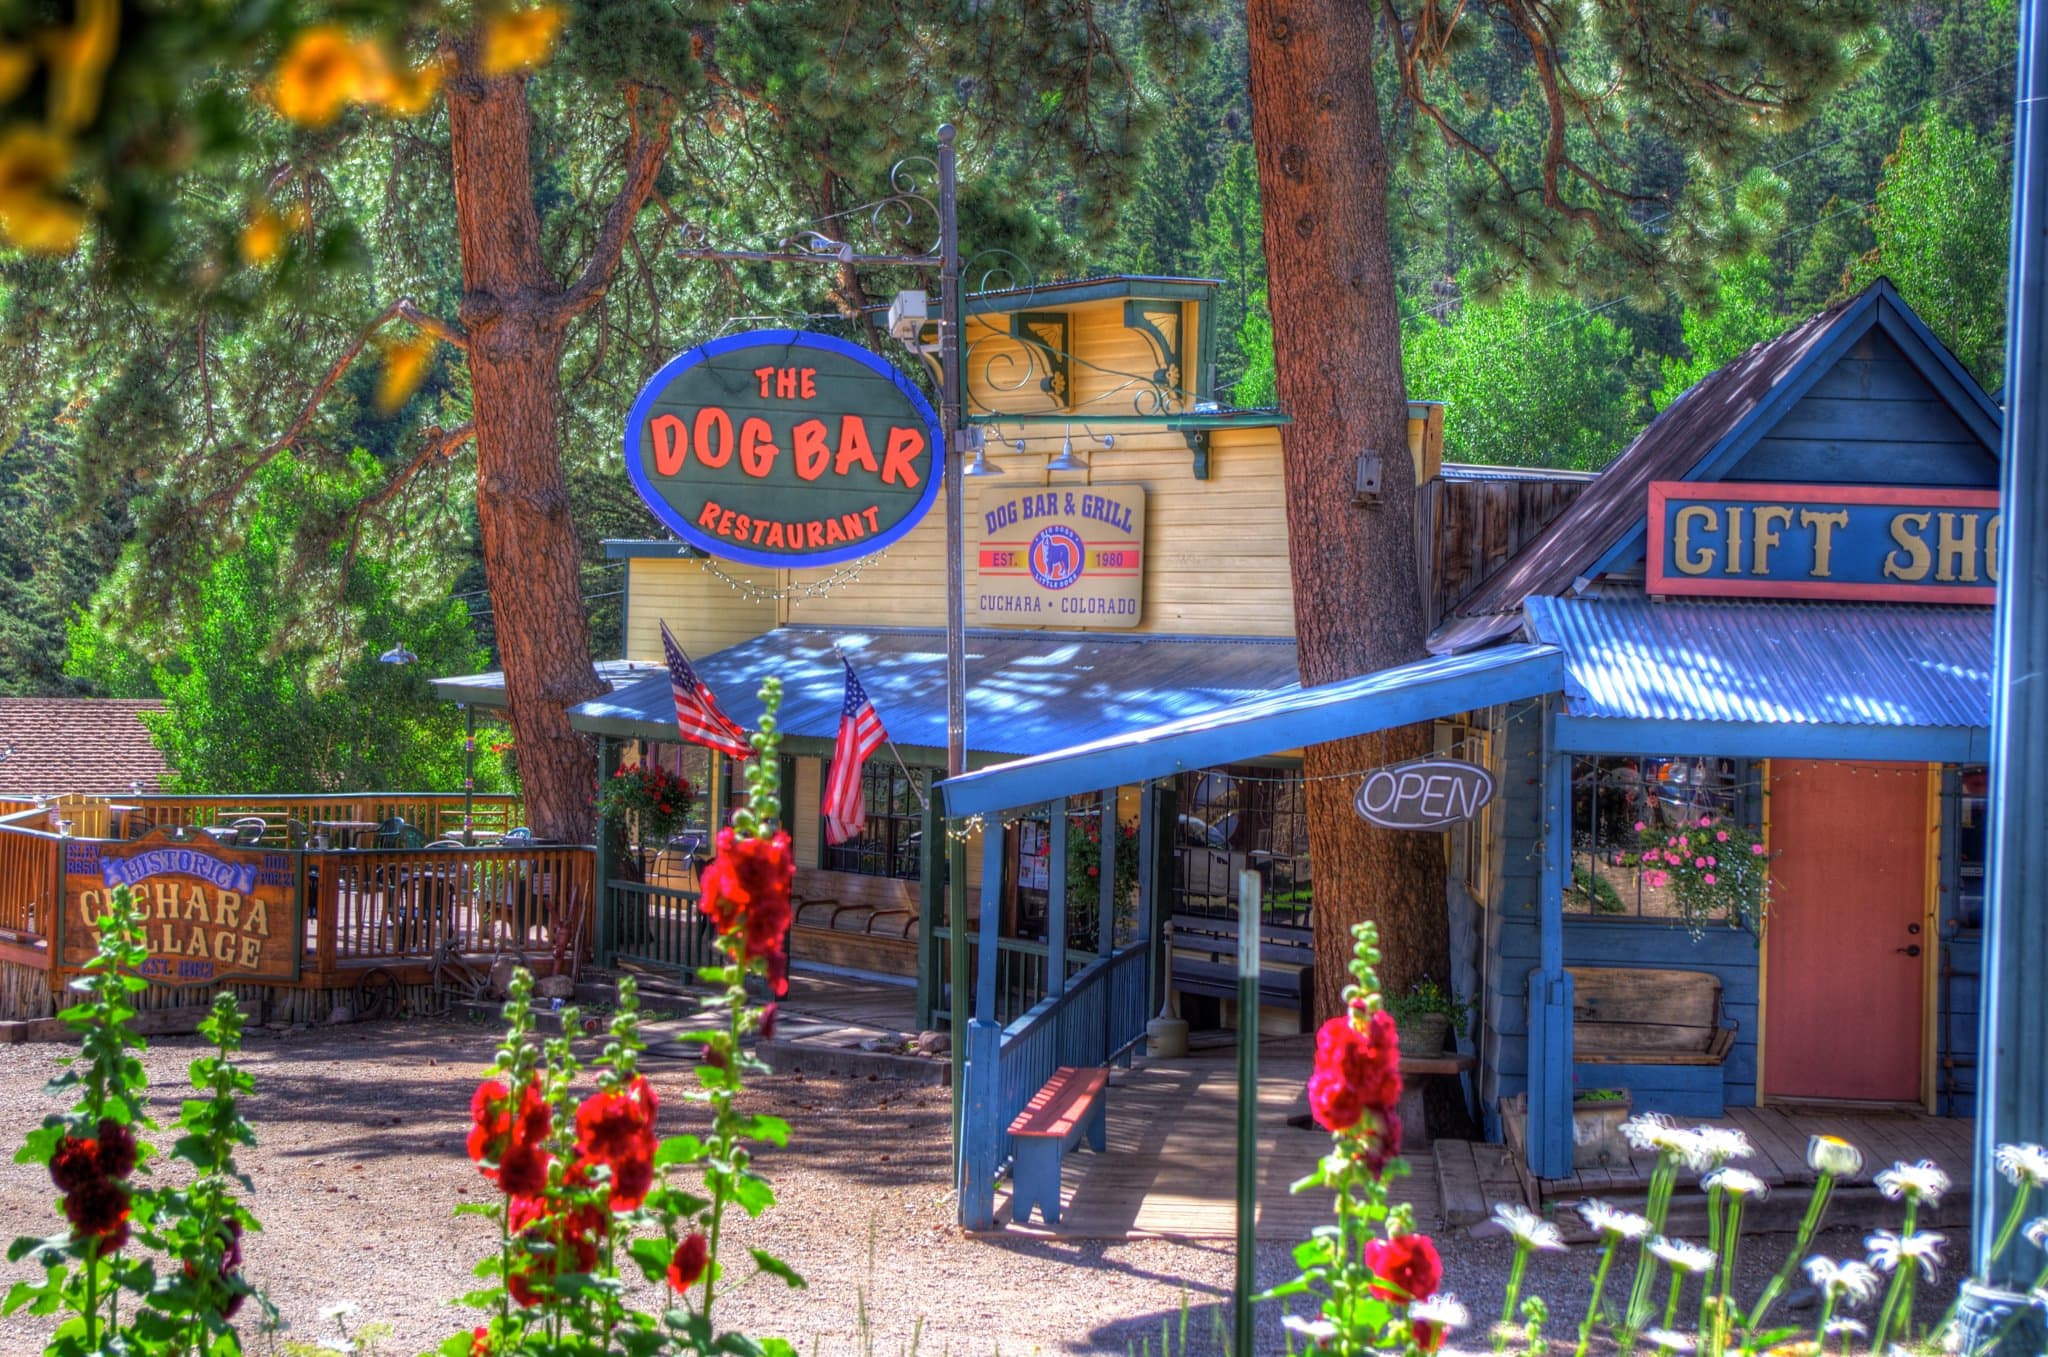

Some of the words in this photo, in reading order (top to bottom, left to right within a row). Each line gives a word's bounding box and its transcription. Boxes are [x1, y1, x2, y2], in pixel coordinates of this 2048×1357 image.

[754, 366, 817, 400] THE
[650, 406, 780, 478] DOG
[792, 415, 926, 489] BAR
[698, 501, 881, 549] RESTAURANT
[984, 499, 1019, 536] DOG
[1021, 492, 1059, 522] BAR
[1063, 492, 1076, 517] &
[1080, 493, 1133, 535] GRILL
[992, 552, 1019, 567] EST.
[1095, 552, 1124, 568] 1980
[1673, 505, 1849, 577] GIFT
[979, 594, 1042, 613] CUCHARA
[1061, 596, 1137, 616] COLORADO
[1364, 771, 1482, 819] OPEN
[122, 848, 234, 886] HISTORIC
